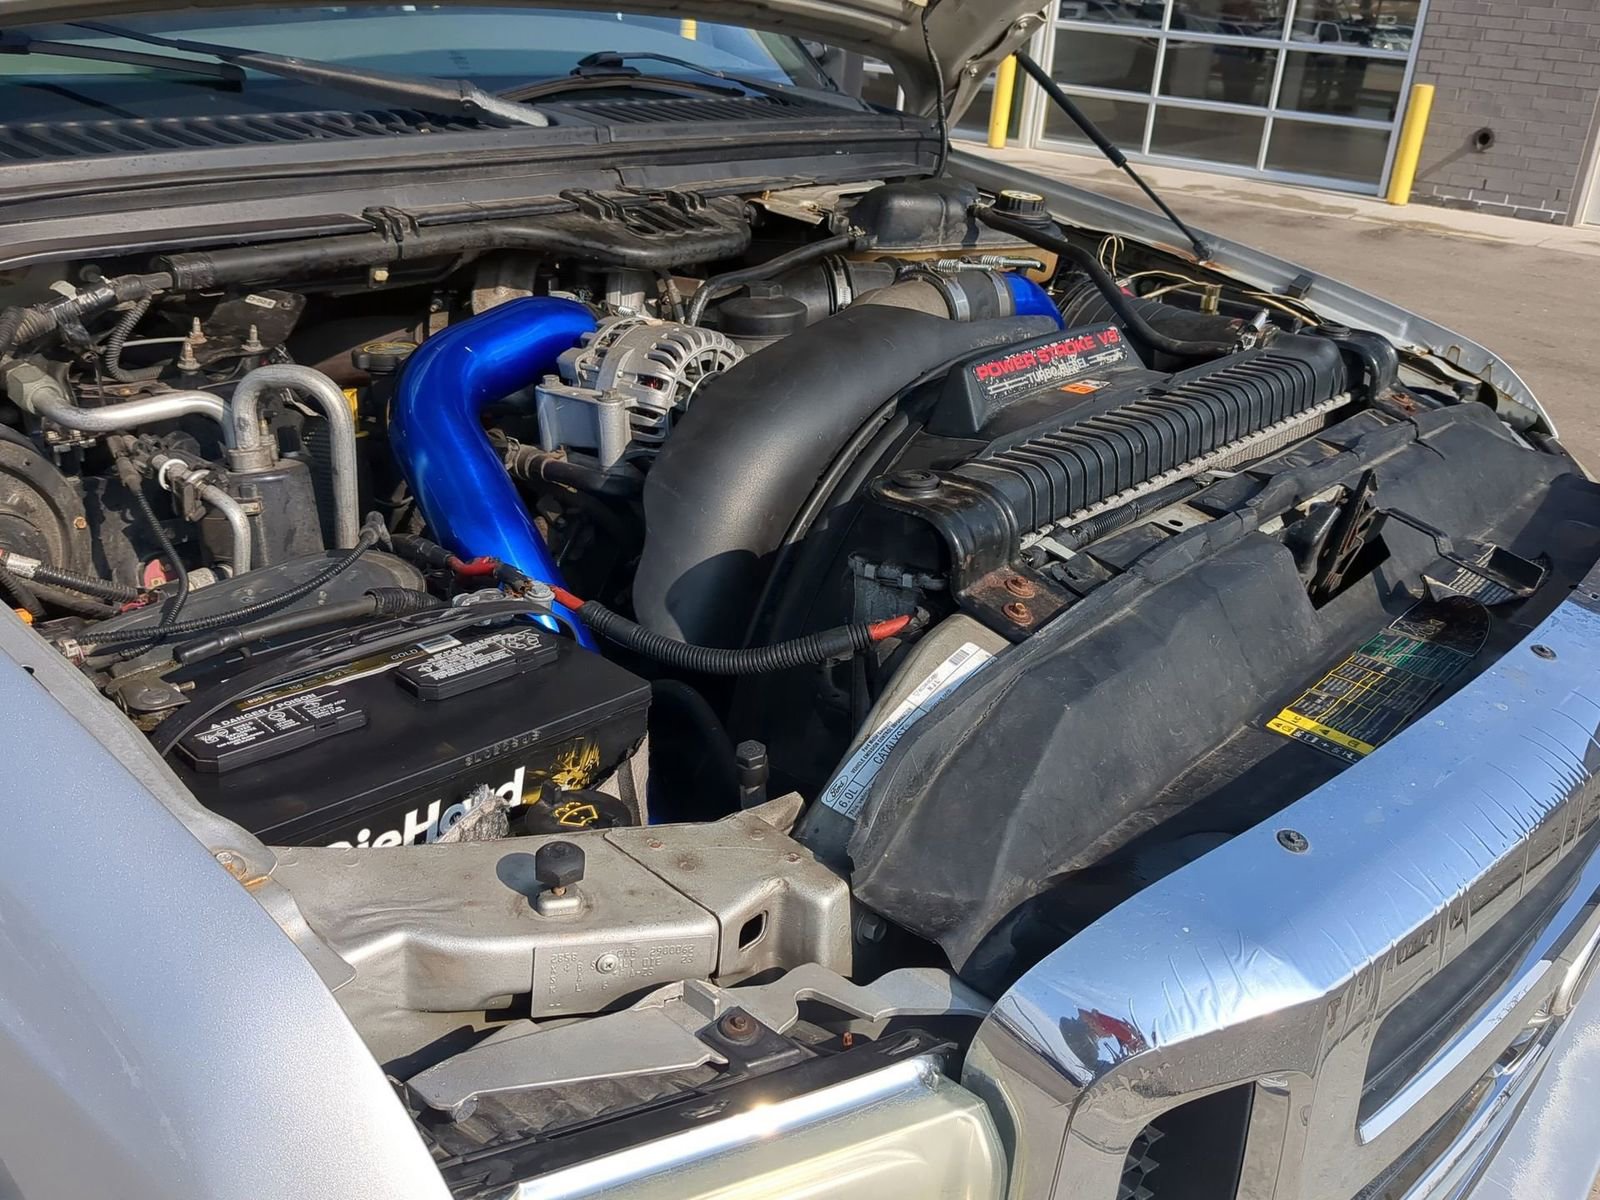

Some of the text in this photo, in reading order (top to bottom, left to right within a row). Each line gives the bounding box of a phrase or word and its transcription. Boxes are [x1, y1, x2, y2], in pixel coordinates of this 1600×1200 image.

[976, 329, 1120, 380] POWER STROKE V8
[390, 649, 418, 660] GOLD
[221, 708, 267, 725] DANGER
[276, 693, 315, 708] POISON
[829, 780, 845, 798] Ford
[839, 787, 858, 808] 6.0L
